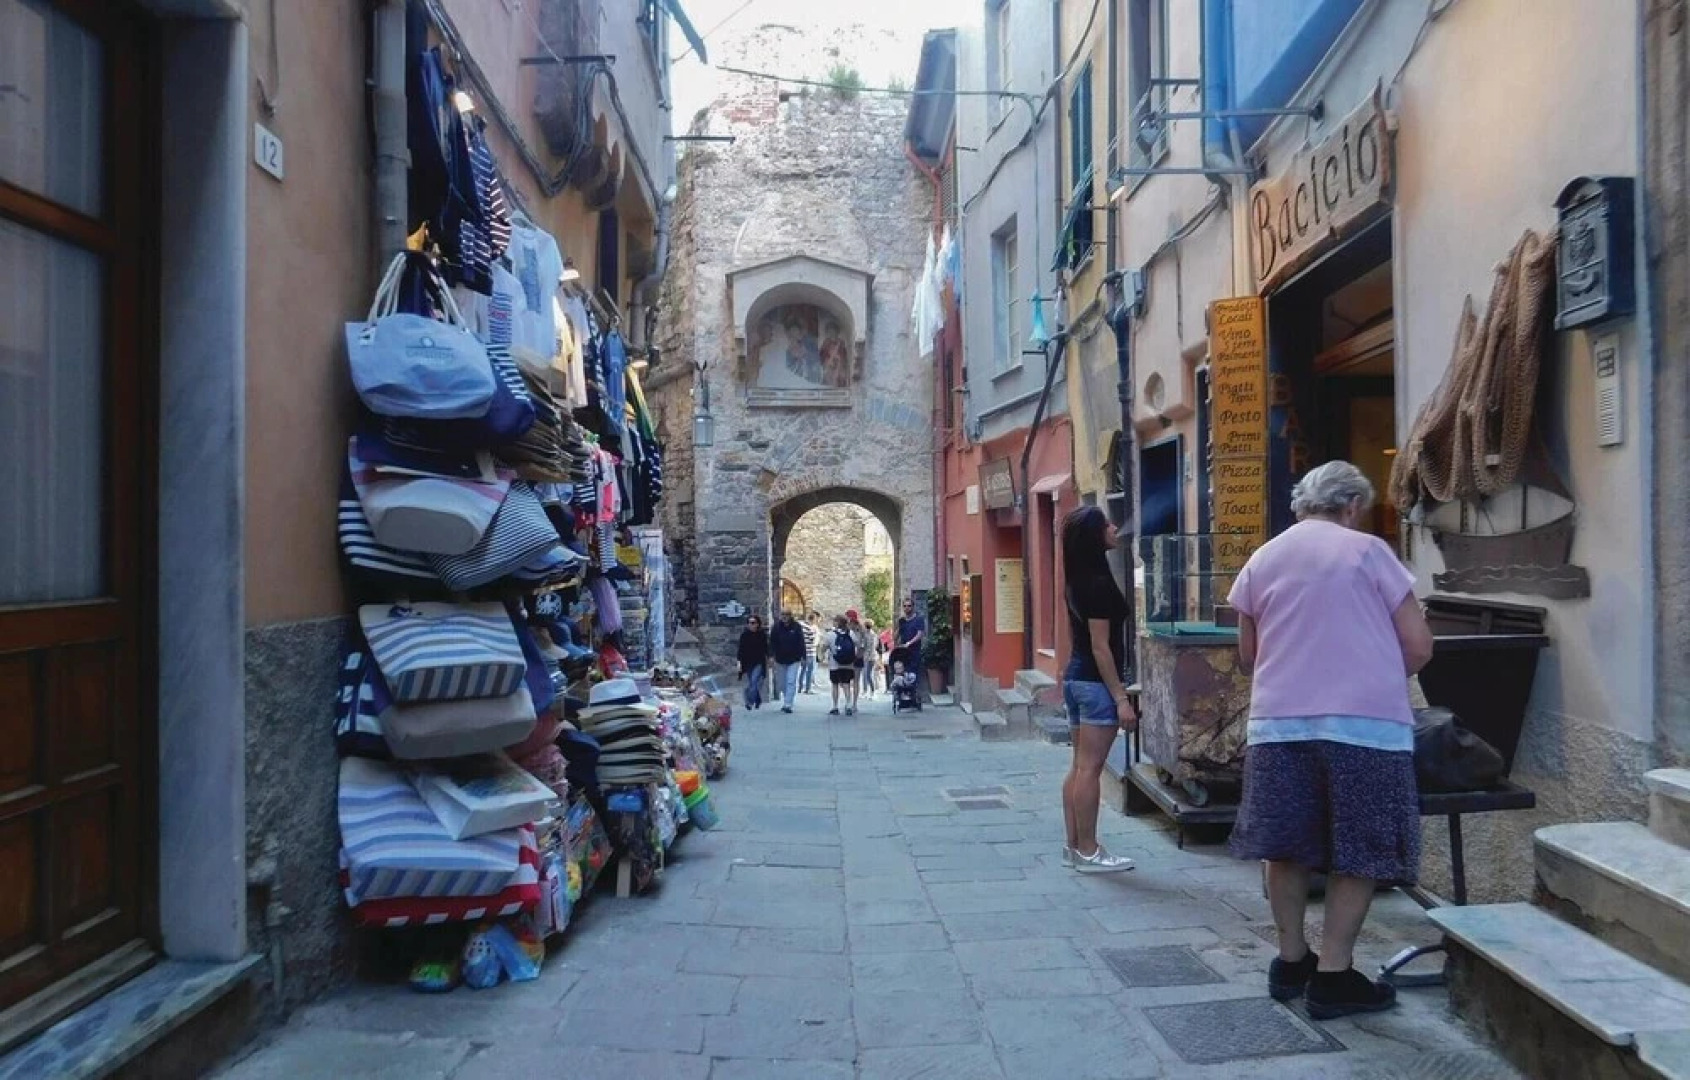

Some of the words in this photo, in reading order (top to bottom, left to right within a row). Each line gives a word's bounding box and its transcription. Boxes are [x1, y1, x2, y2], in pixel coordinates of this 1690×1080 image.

[262, 134, 278, 168] 12
[1252, 113, 1379, 281] Bacicio
[1219, 328, 1251, 340] Vino
[1218, 382, 1254, 395] Piatti
[1219, 409, 1261, 425] Pesto
[1226, 430, 1261, 443] Primi
[1219, 464, 1260, 478] Pizza
[1221, 500, 1260, 516] Toast
